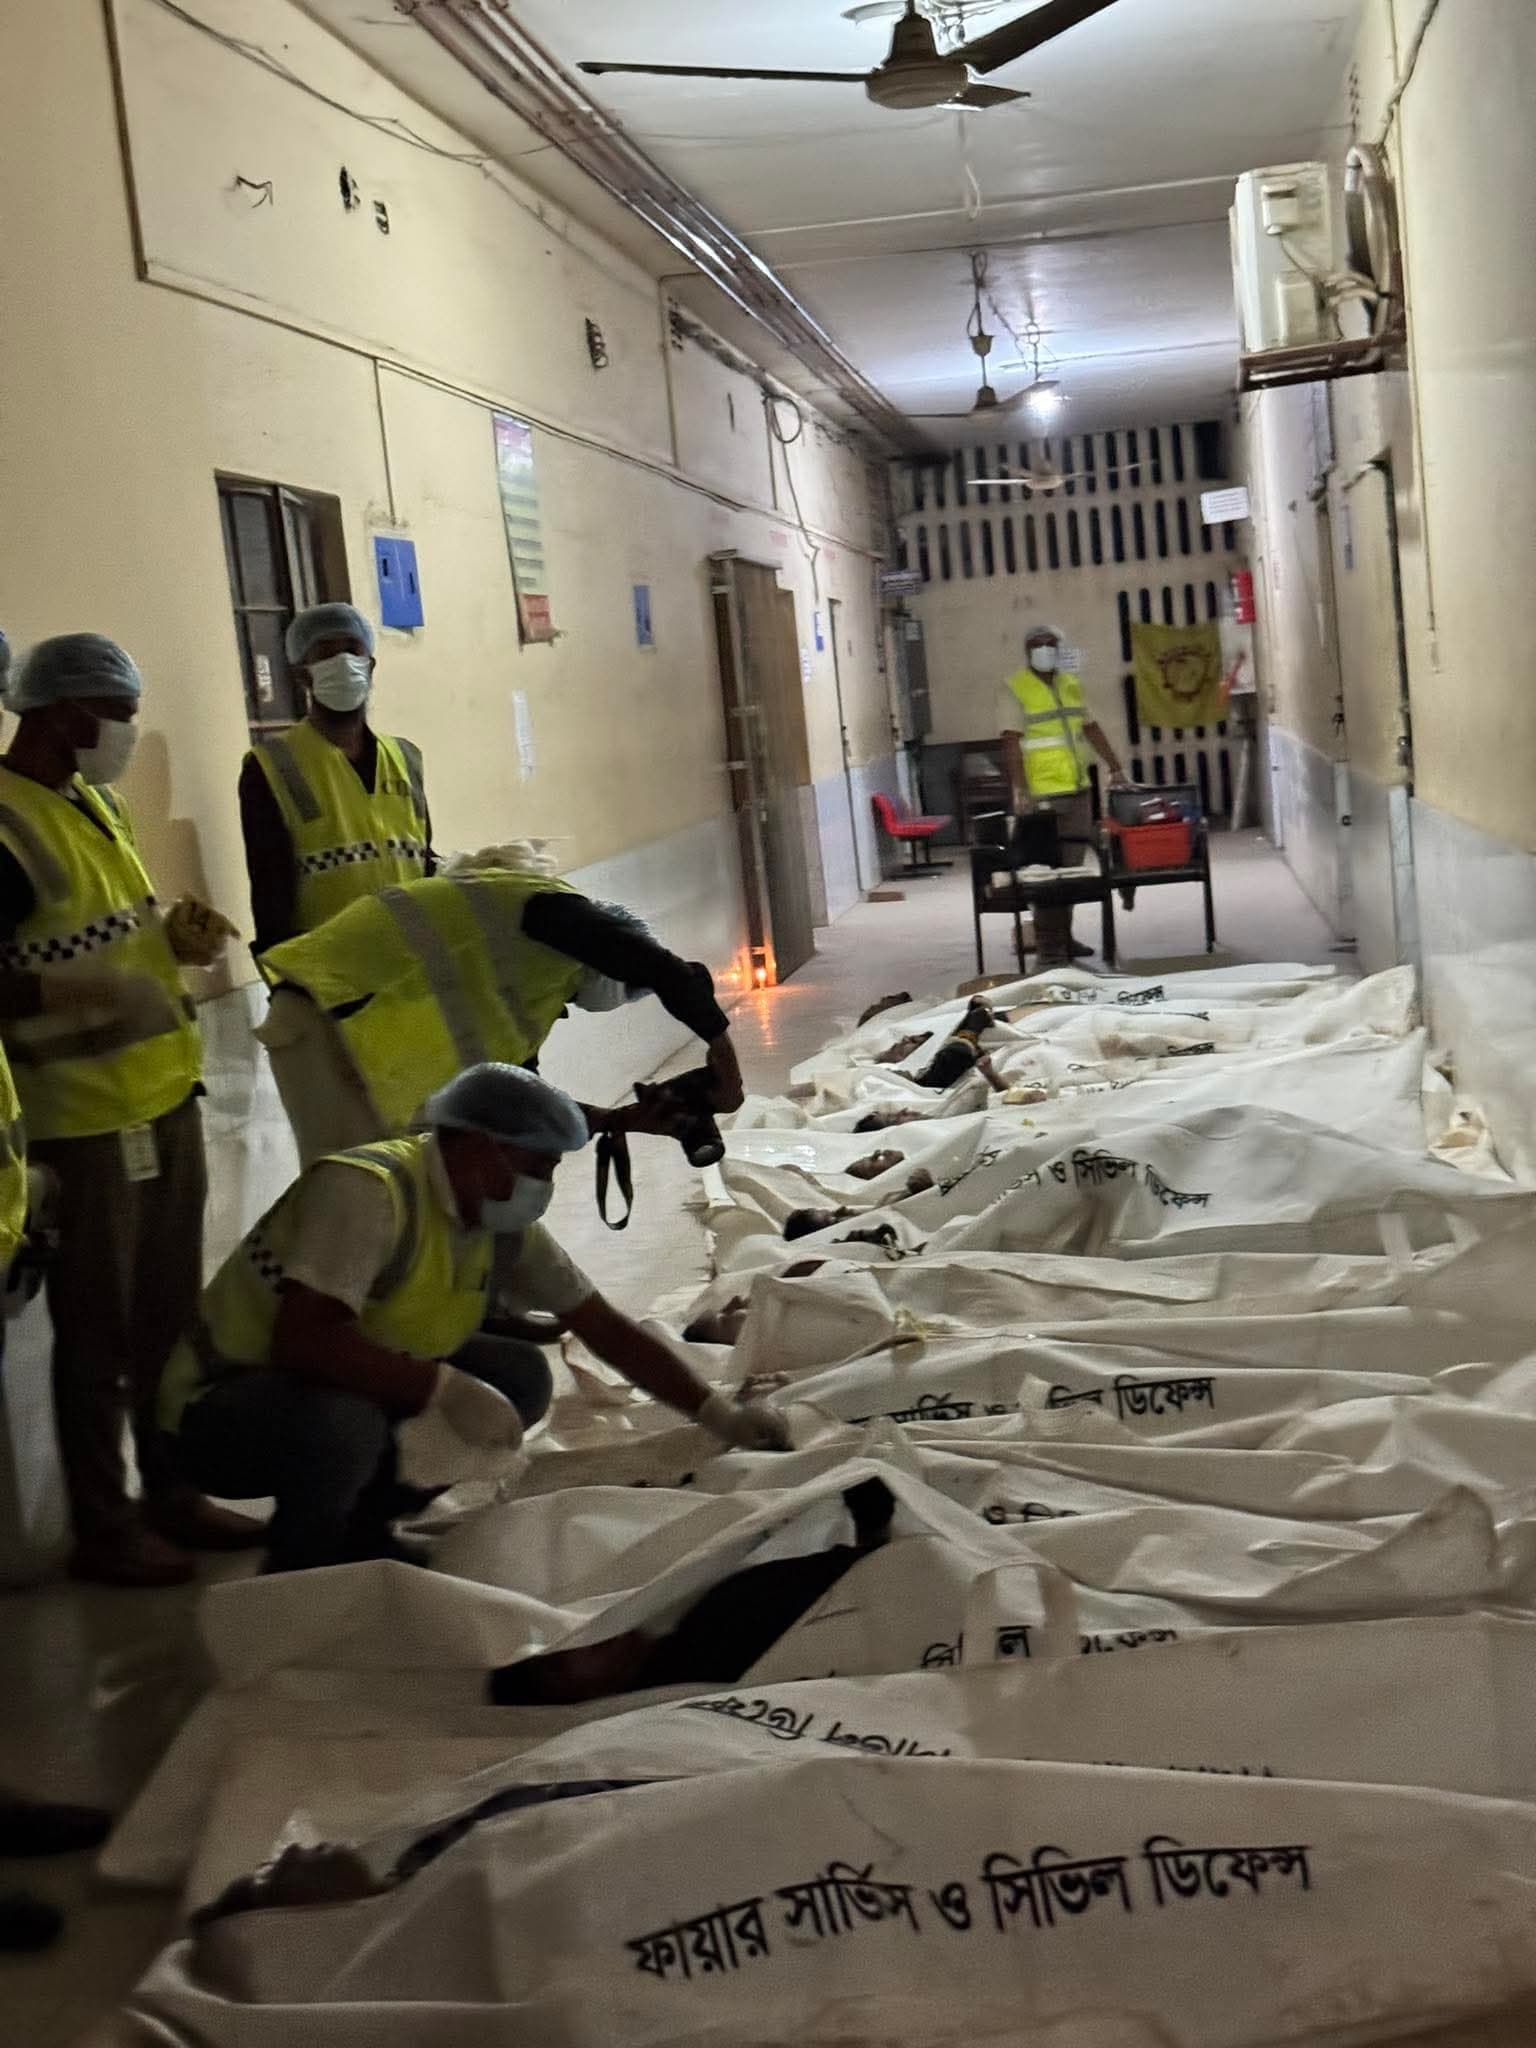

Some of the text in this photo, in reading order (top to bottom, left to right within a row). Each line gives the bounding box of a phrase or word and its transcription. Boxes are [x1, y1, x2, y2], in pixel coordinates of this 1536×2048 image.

[1113, 1374, 1216, 1420] ডিফেন্স
[626, 1835, 1311, 1979] ফায়ার সার্ভিস ও সিভিল ডিফেন্স
